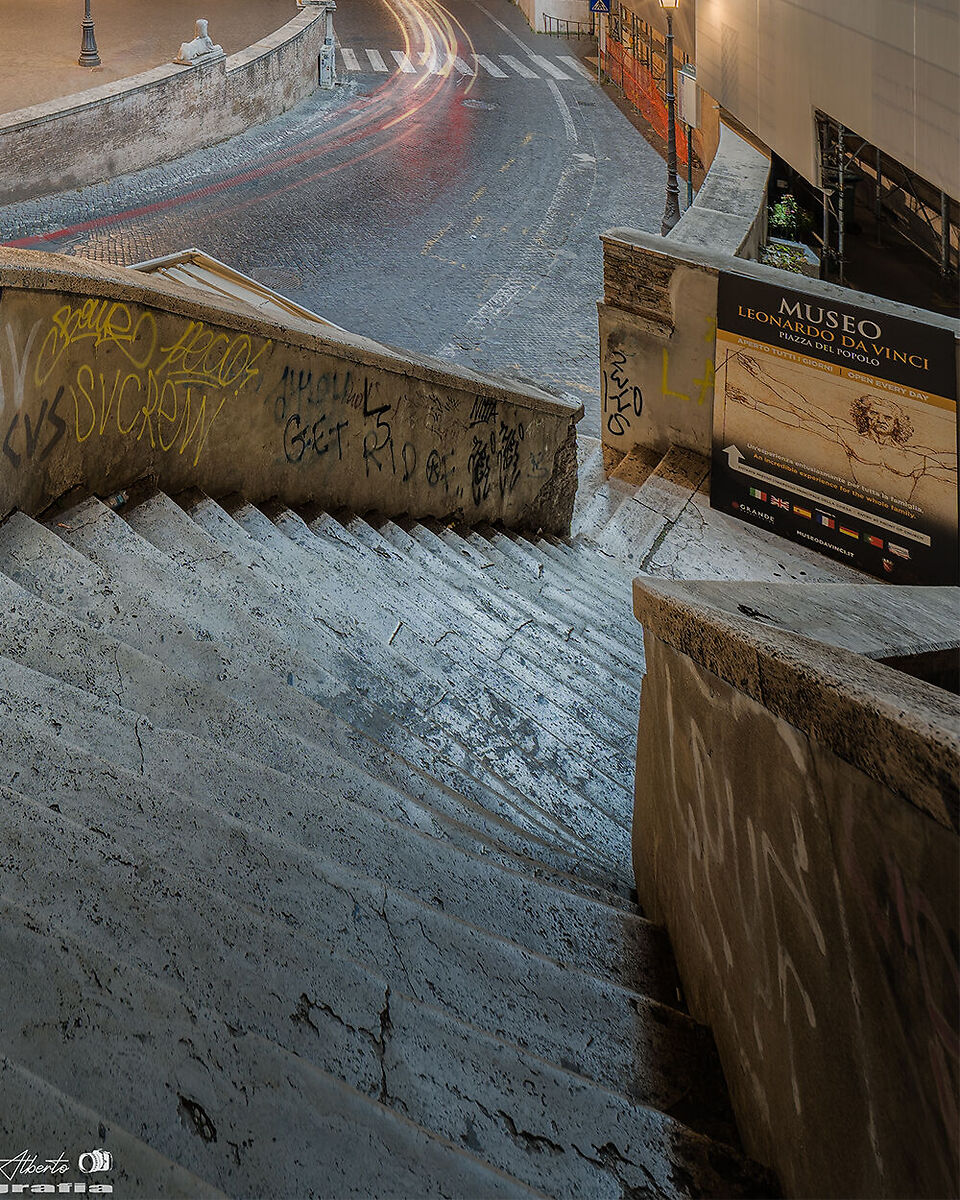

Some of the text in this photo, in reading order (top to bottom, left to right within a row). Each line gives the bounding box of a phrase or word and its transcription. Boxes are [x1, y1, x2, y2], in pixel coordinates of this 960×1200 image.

[737, 304, 930, 371] LEONARDO DA VINCI
[778, 297, 883, 341] MUSEO
[737, 337, 771, 353] APERTO
[772, 346, 796, 361] TUTTI
[802, 357, 834, 373] GIORNI
[778, 331, 881, 367] PIAZZA DEL POPOLO
[847, 370, 930, 402] OPEN EVERY DAY
[764, 456, 798, 474] incredible
[799, 471, 838, 490] experience
[852, 490, 865, 500] the
[866, 496, 889, 509] whole
